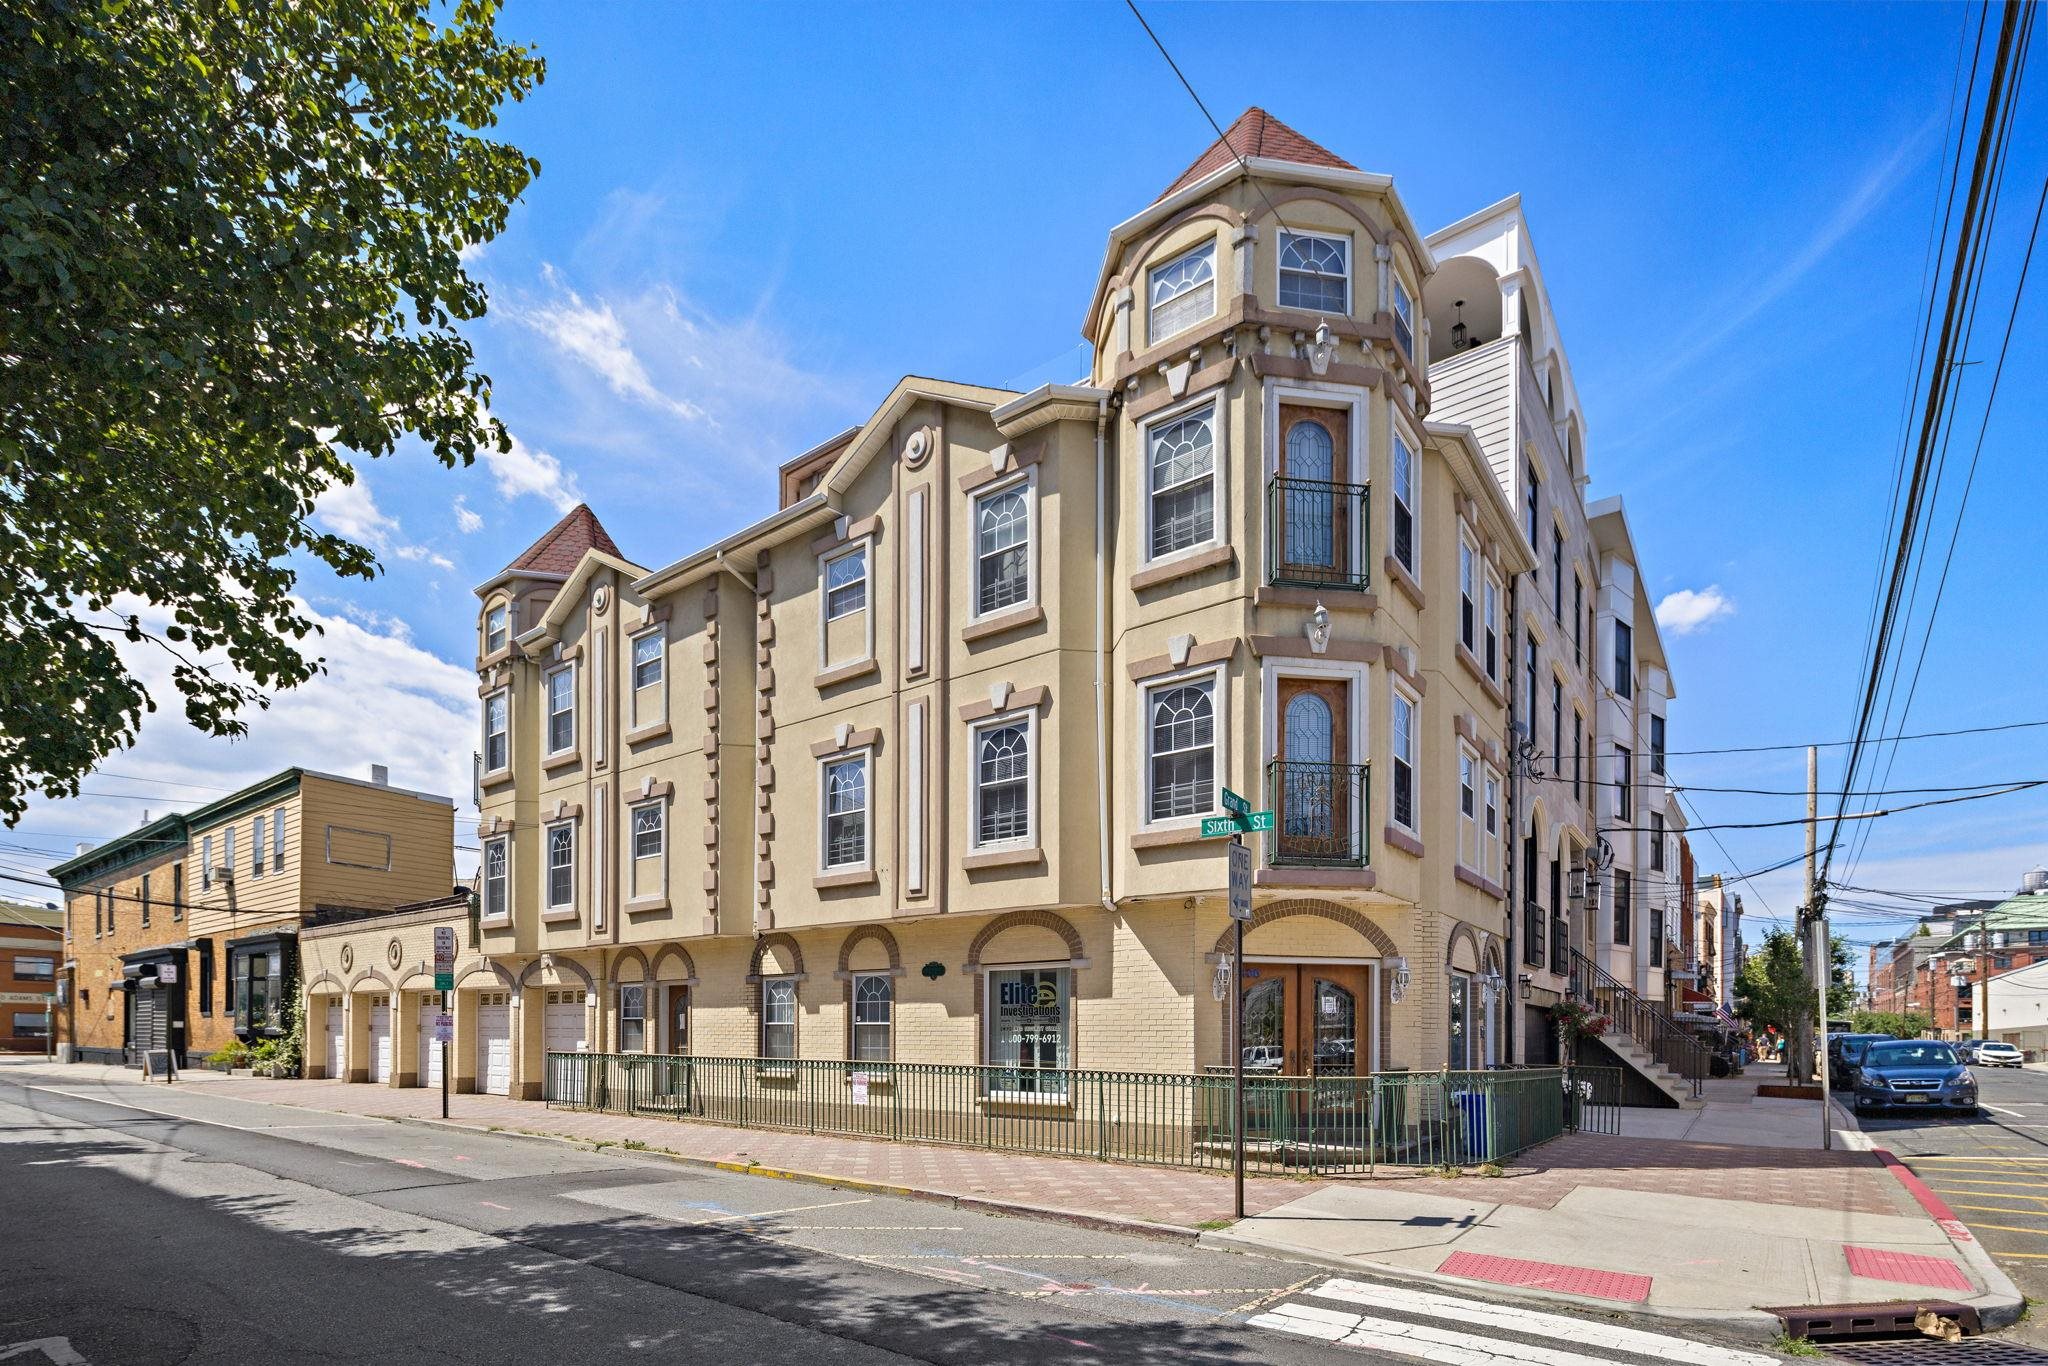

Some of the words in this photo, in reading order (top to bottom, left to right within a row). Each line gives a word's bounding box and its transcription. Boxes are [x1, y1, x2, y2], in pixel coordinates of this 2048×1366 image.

[1224, 791, 1239, 811] Grand
[1207, 819, 1235, 835] Sixth
[1253, 815, 1267, 830] St
[1231, 850, 1249, 870] ONE
[1231, 870, 1249, 890] WAY
[1001, 981, 1038, 1005] Elite
[1000, 1006, 1061, 1017] Investigations
